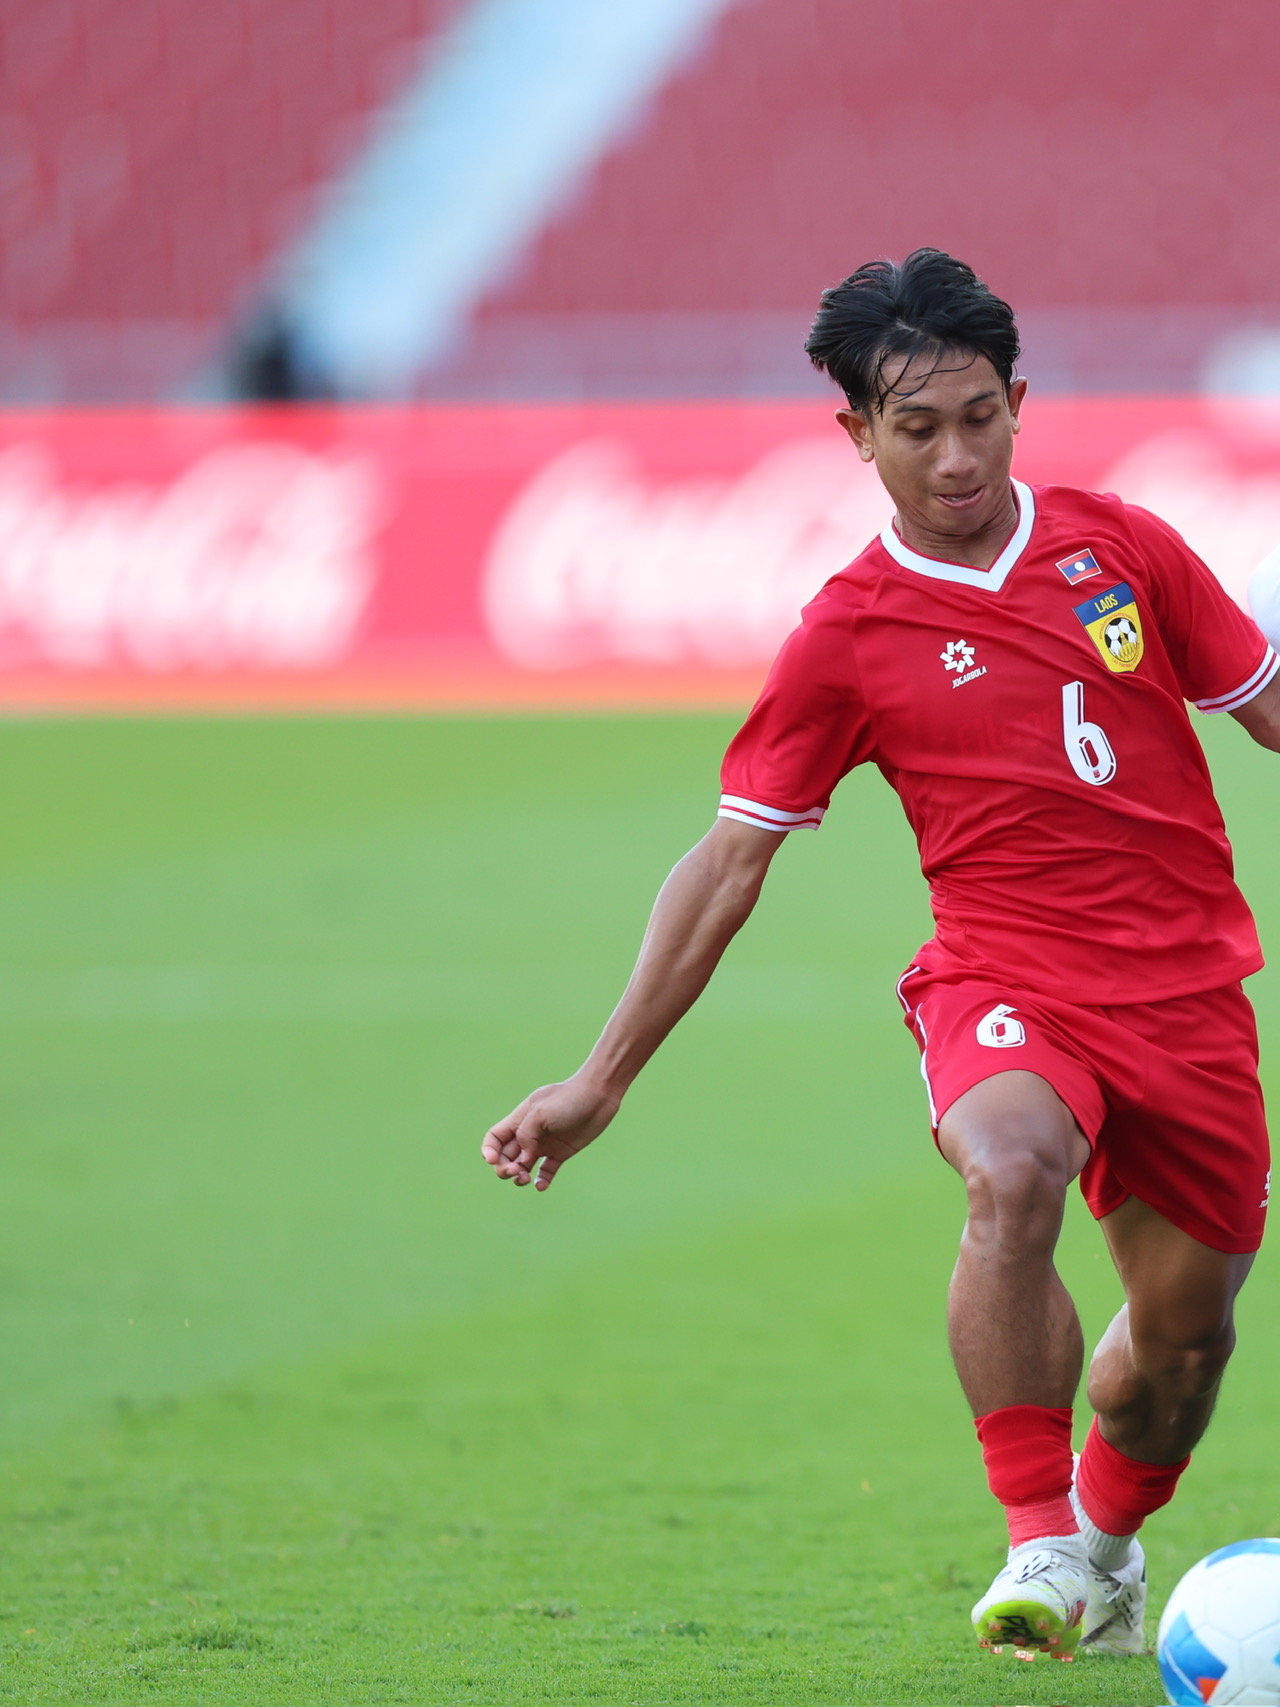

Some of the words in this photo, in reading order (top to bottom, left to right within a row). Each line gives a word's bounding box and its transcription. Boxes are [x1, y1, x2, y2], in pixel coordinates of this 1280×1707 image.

[1094, 593, 1119, 614] LAOS
[1062, 680, 1118, 786] 6
[976, 1003, 1027, 1049] 6
